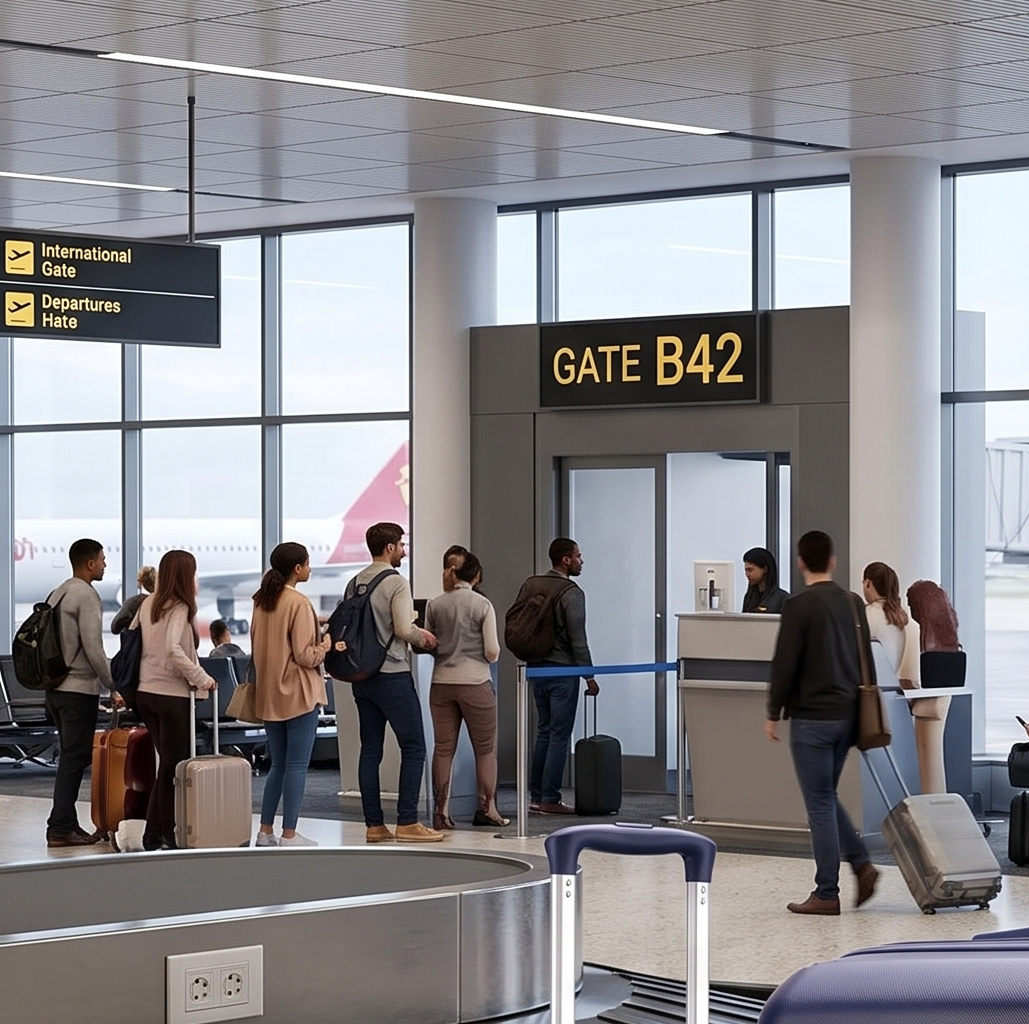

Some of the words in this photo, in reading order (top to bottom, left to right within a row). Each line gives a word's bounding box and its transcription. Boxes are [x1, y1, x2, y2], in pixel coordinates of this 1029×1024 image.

[41, 242, 132, 264] International
[41, 262, 77, 278] Gate
[42, 294, 121, 314] Departures
[42, 312, 78, 329] Hate
[553, 344, 641, 385] GATE
[656, 331, 744, 386] B42
